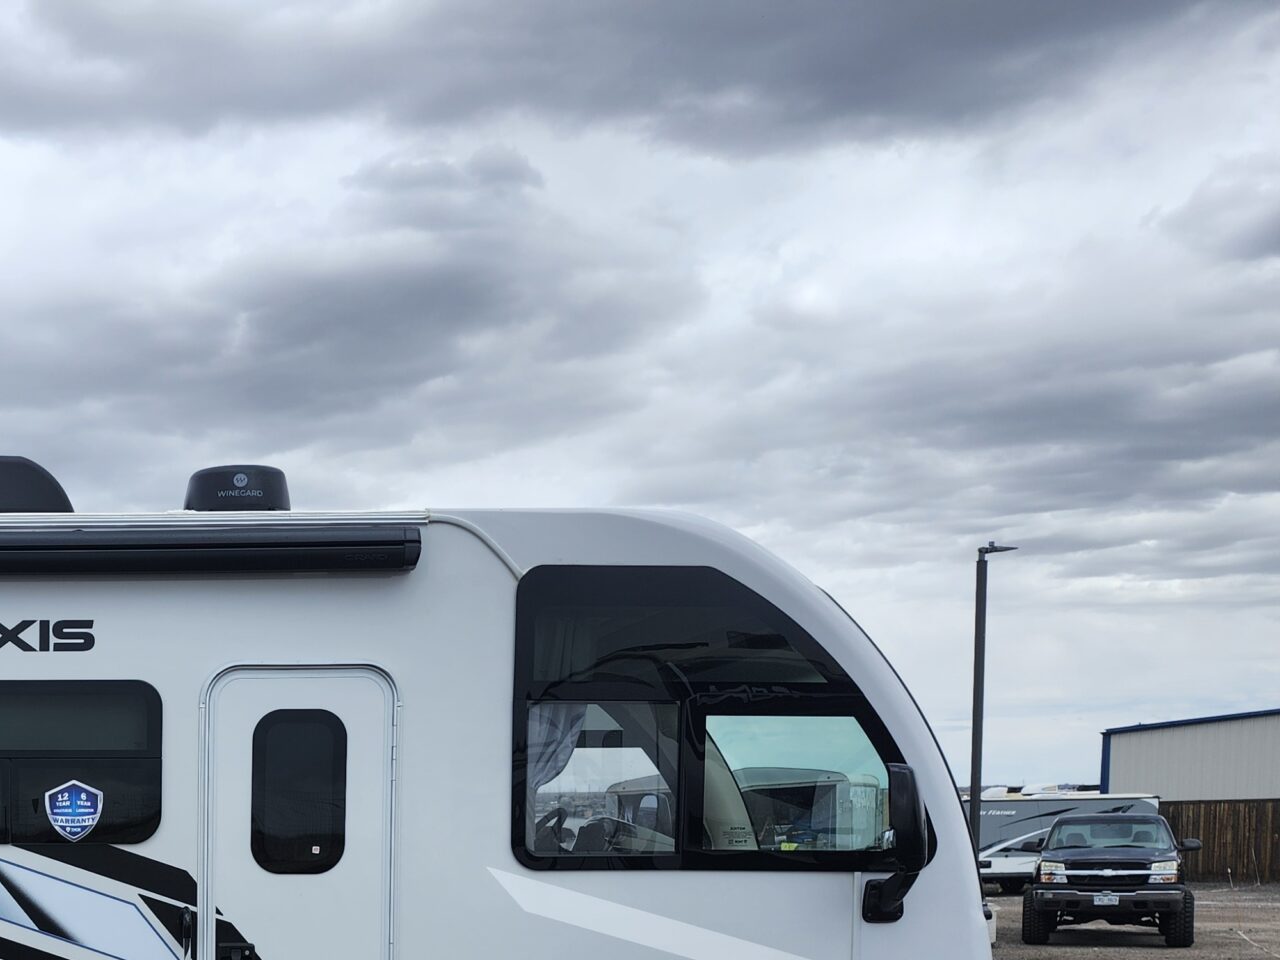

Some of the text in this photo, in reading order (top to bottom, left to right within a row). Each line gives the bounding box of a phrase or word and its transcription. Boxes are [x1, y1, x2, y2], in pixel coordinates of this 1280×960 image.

[217, 489, 264, 497] WINEGARD
[57, 792, 69, 801] 12
[80, 792, 87, 801] 6
[52, 816, 96, 825] WARRANTY
